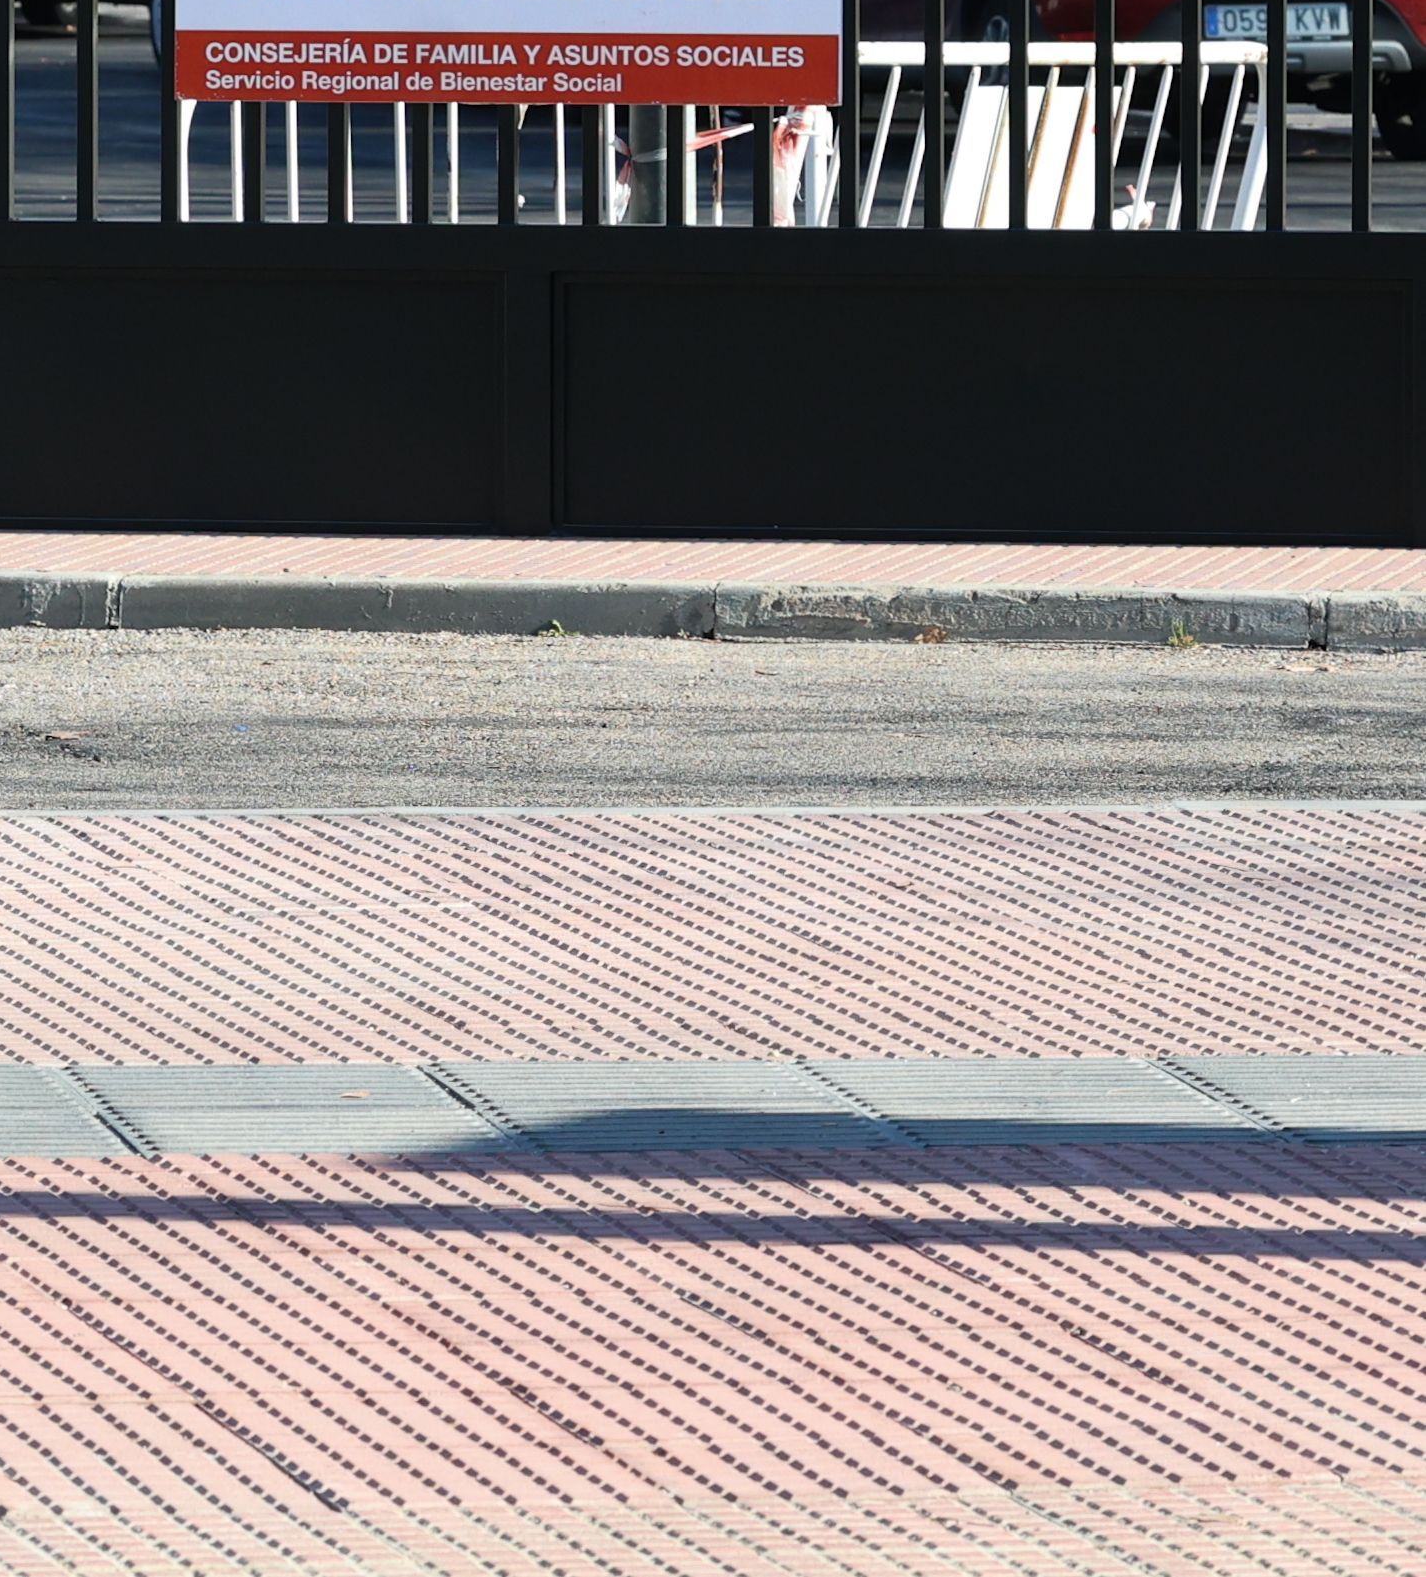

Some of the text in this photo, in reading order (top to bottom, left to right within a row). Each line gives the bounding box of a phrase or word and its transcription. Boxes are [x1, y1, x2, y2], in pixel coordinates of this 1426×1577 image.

[1223, 7, 1340, 32] 059 KVW
[205, 39, 805, 68] CONSEJERÍA DE FAMILIA Y ASUNTOS SOCIALES
[205, 69, 622, 94] Servicio Regional de Bienestar Social
